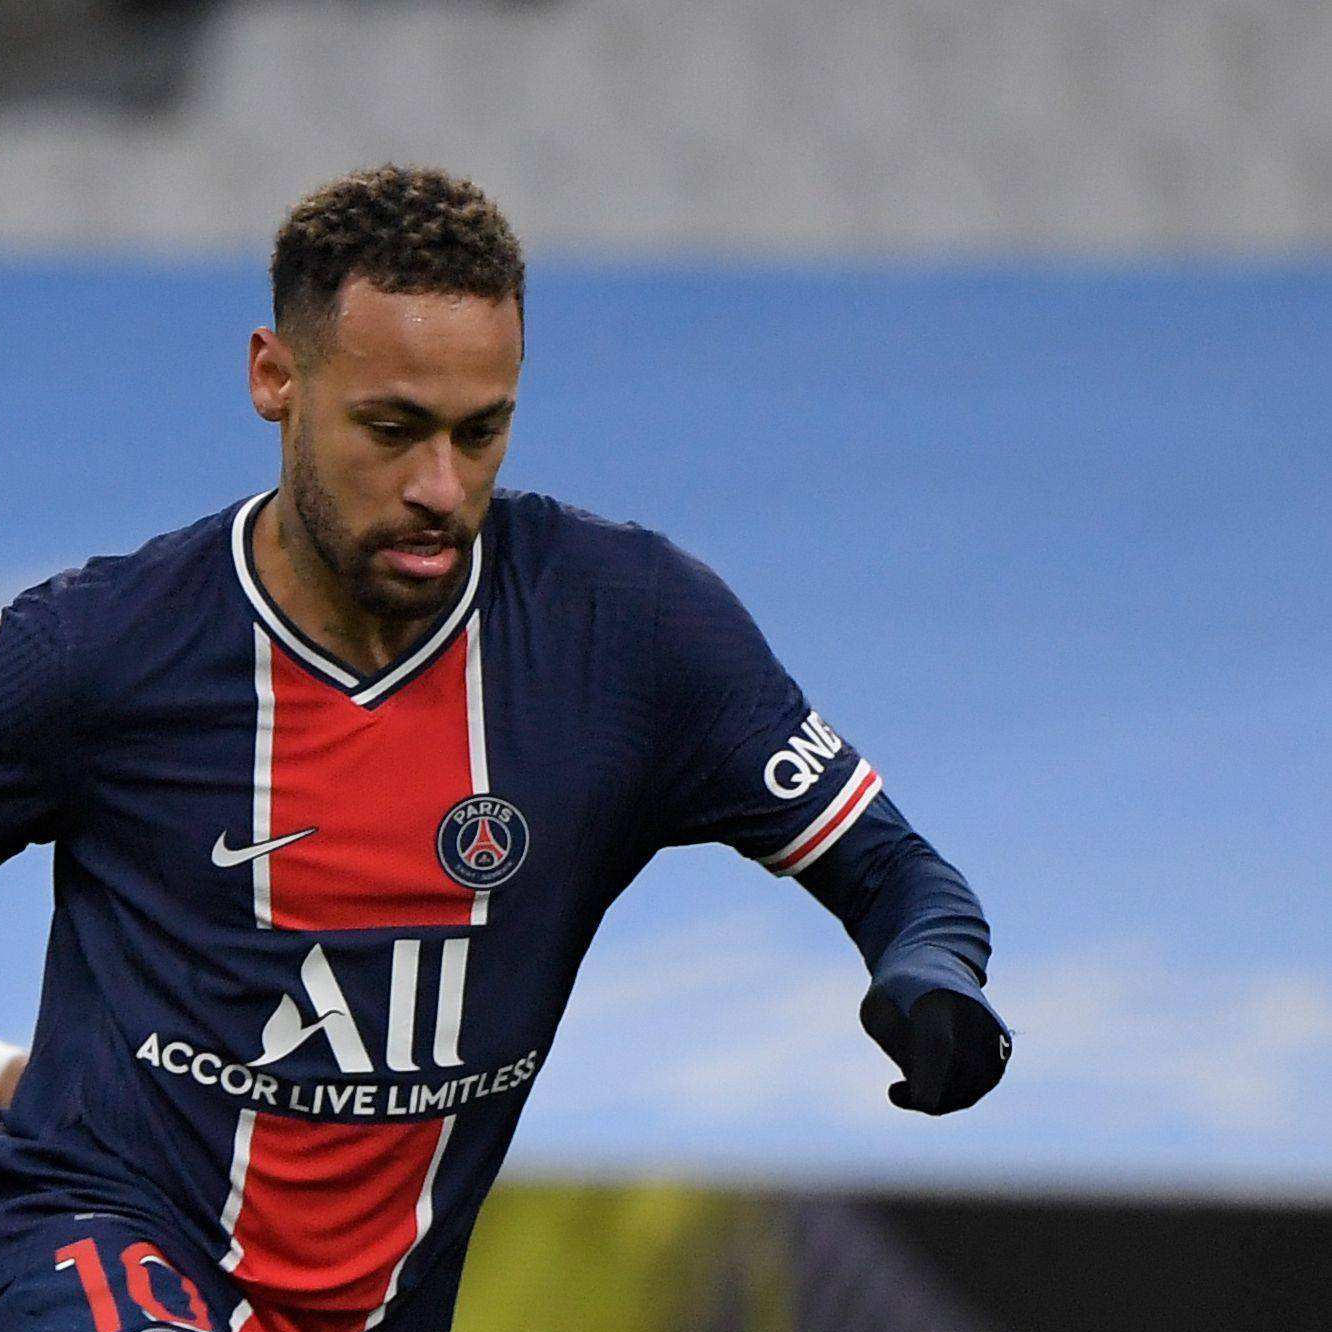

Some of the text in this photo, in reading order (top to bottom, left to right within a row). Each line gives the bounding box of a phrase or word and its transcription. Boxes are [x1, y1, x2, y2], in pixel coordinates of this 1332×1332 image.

[453, 802, 513, 825] PARIS
[135, 1031, 538, 1116] ACCOR LIVE LIMITLESS
